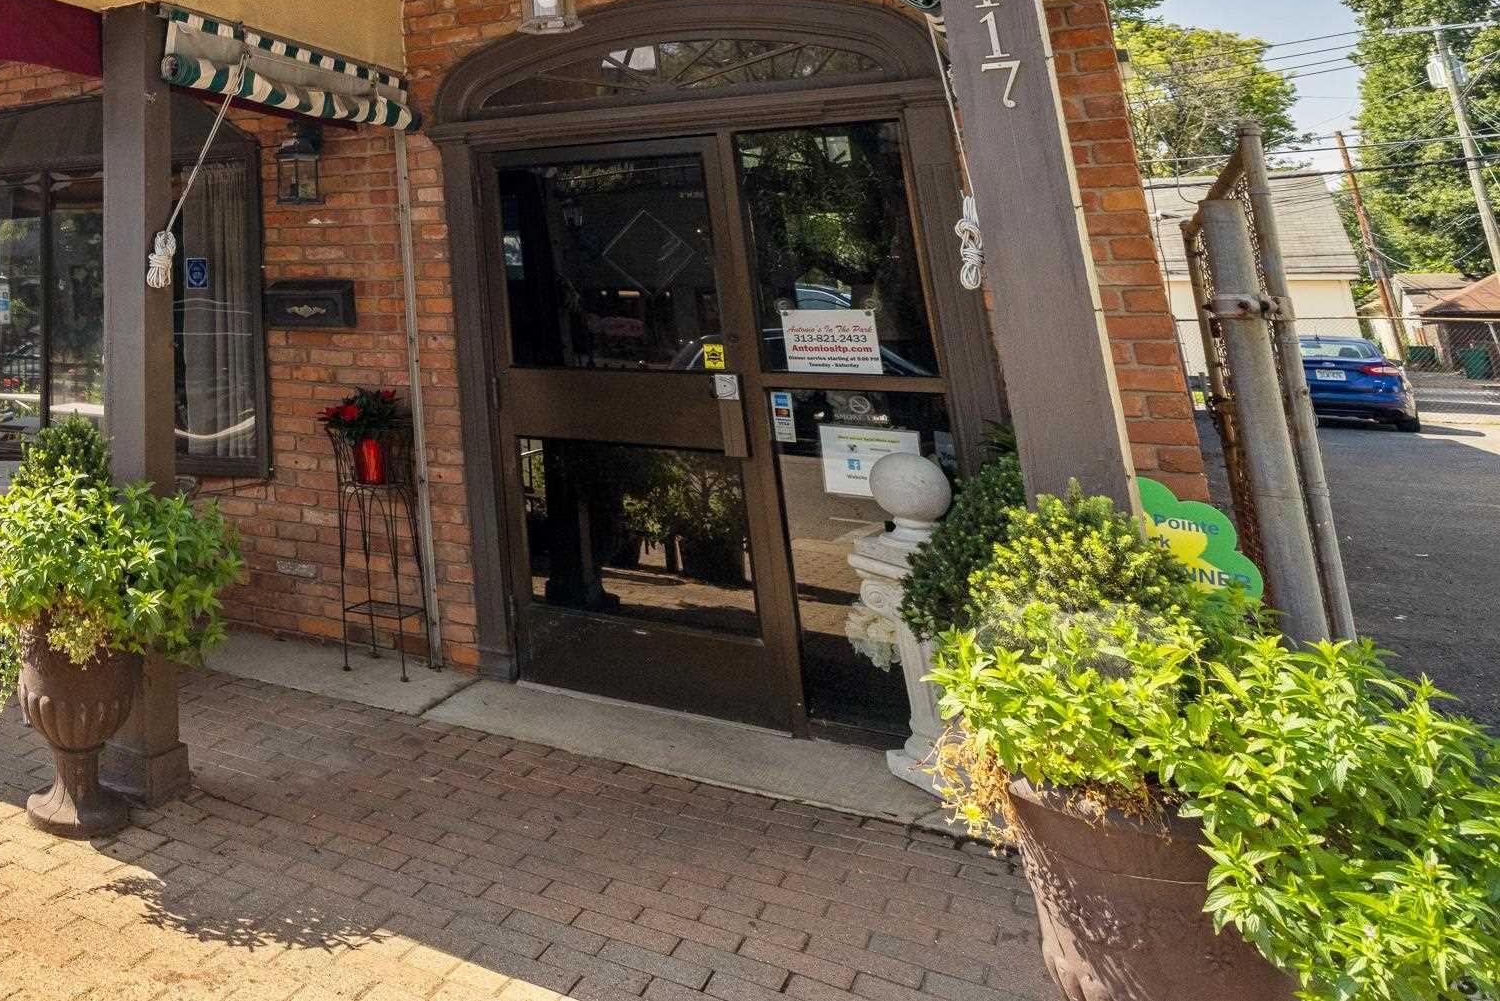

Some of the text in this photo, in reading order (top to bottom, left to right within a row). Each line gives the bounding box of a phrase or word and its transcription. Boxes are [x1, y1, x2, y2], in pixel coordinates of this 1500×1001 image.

[793, 334, 867, 342] 313-821-2433
[792, 345, 873, 353] Antoniositp.com
[1153, 511, 1220, 536] Pointe
